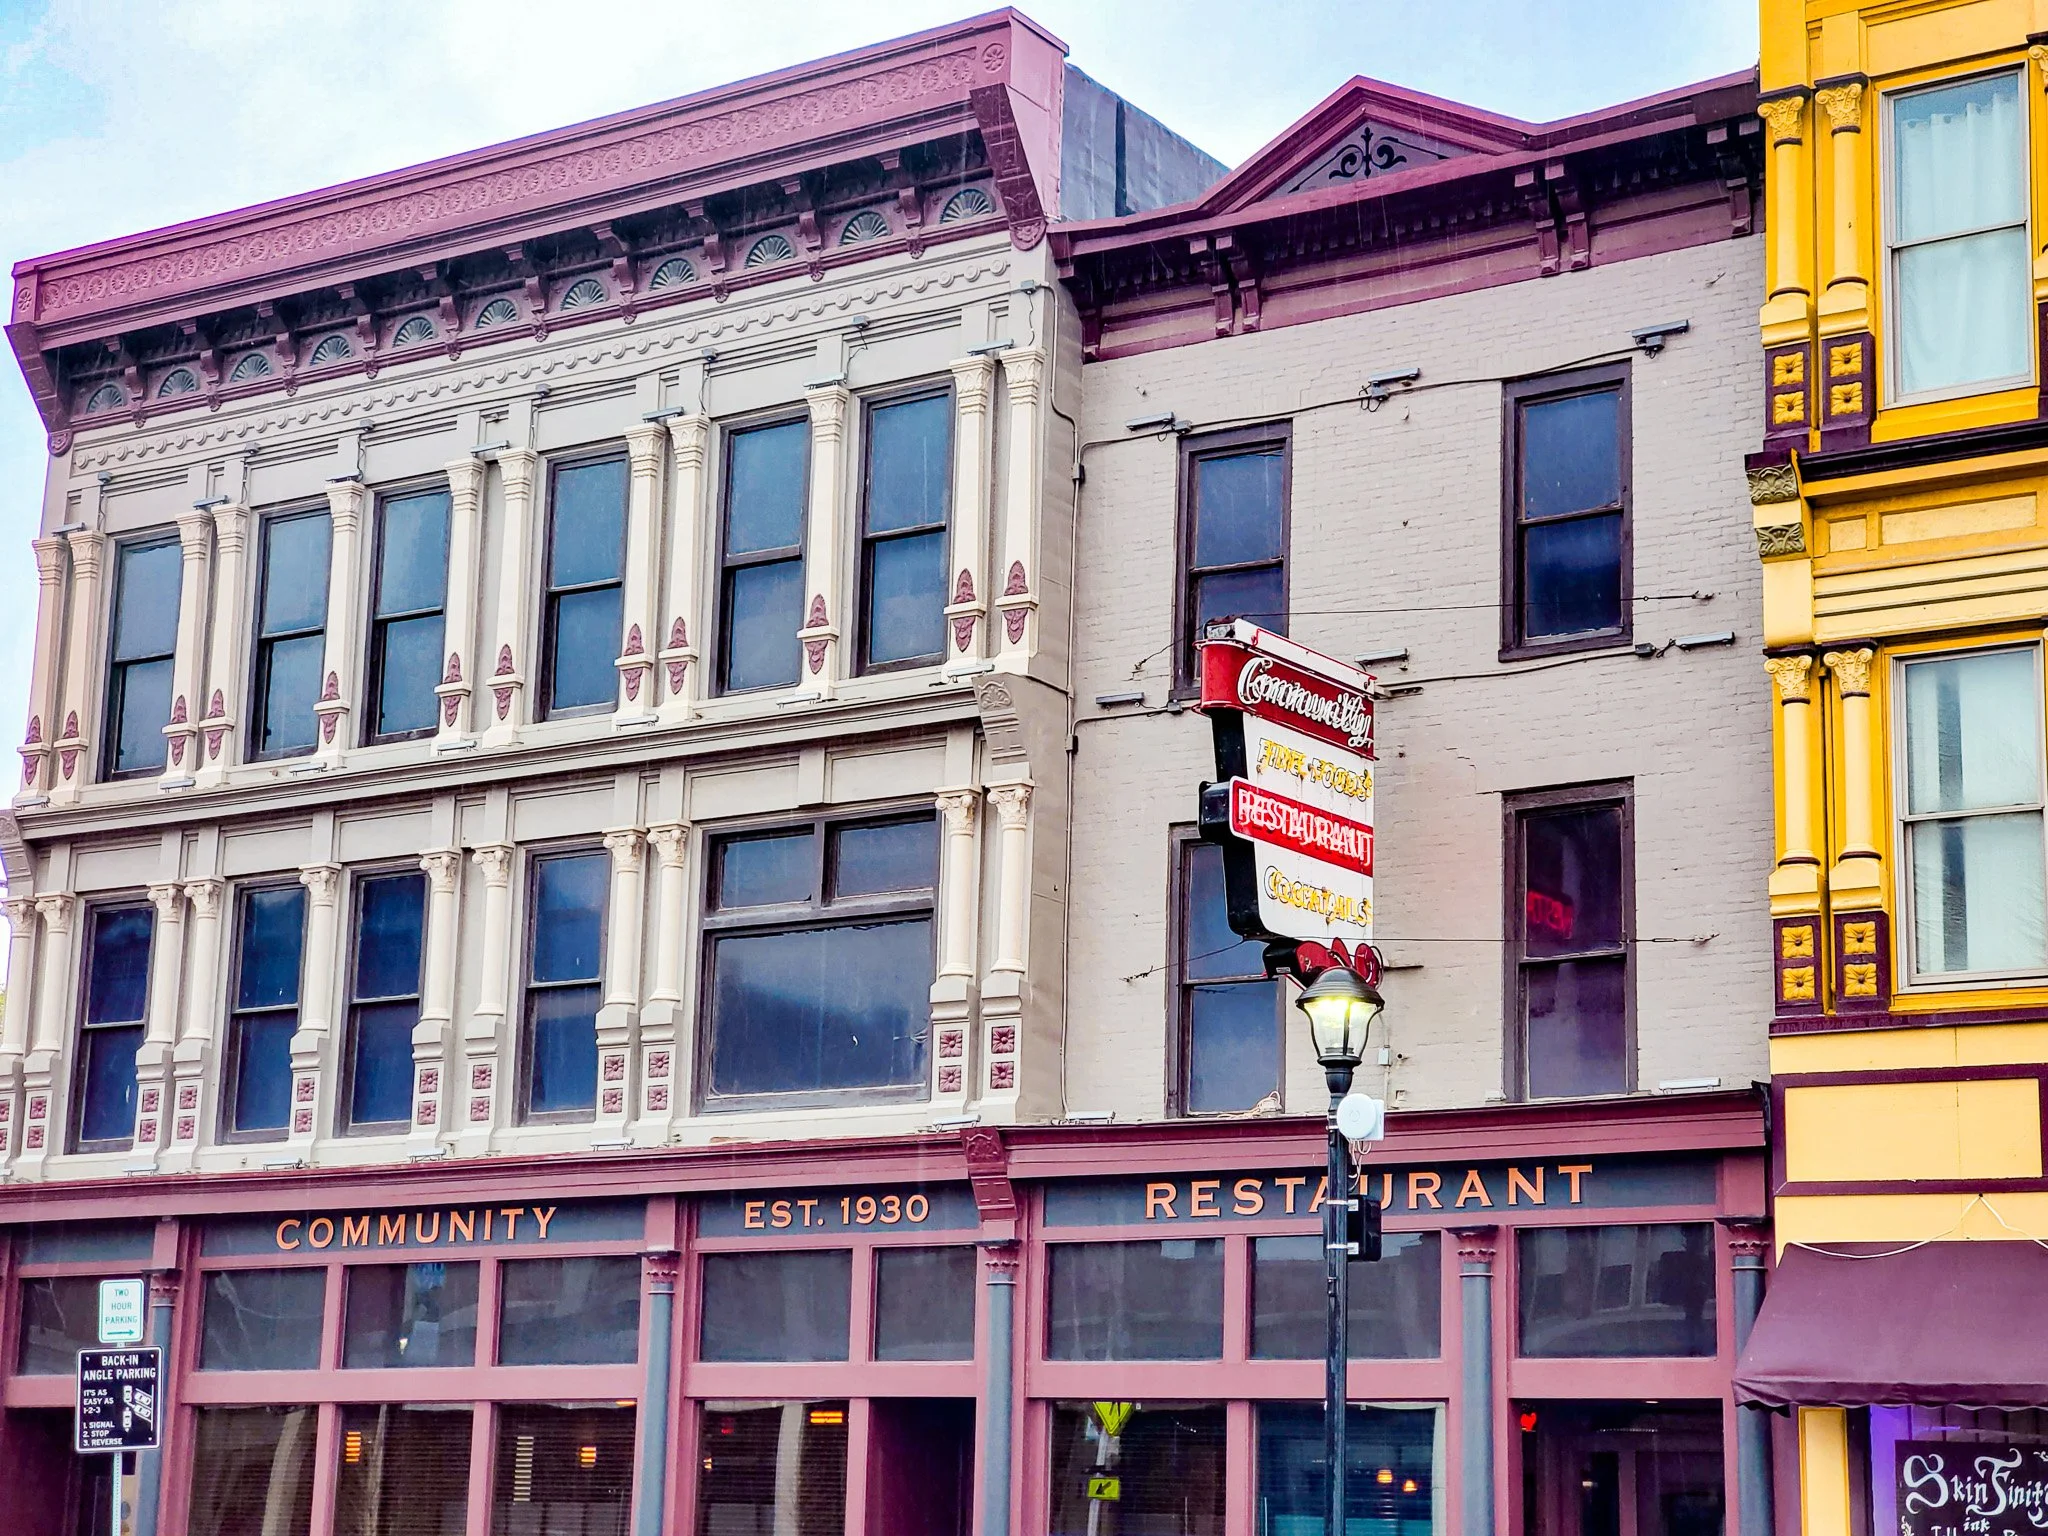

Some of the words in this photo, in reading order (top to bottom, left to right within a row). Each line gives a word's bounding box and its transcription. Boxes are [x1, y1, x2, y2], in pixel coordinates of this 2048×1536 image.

[1237, 656, 1374, 748] Community
[1257, 738, 1306, 777] FINE
[1238, 787, 1374, 867] RESTAURANT
[1264, 865, 1372, 928] COCKTAILS
[744, 1200, 824, 1229] EST.
[840, 1194, 930, 1224] 1930
[275, 1206, 557, 1250] COMMUNITY
[114, 1288, 130, 1297] TWO
[111, 1302, 132, 1311] HOUR
[104, 1315, 138, 1325] PARKING
[101, 1354, 139, 1367] BACK-IN
[83, 1369, 114, 1381] ANGLE
[116, 1367, 156, 1380] PARKING
[83, 1389, 97, 1397] IT'S
[97, 1388, 108, 1397] AS
[83, 1398, 103, 1406] EASY
[103, 1397, 114, 1405] AS
[83, 1406, 101, 1415] 1-2-3
[82, 1421, 88, 1430] 1.
[88, 1420, 116, 1429] SIGNAL
[82, 1430, 90, 1438] 2.
[91, 1429, 110, 1438] STOP
[82, 1439, 90, 1447] 3.
[91, 1437, 123, 1446] REVERSE
[1963, 1517, 1991, 1533] ink
